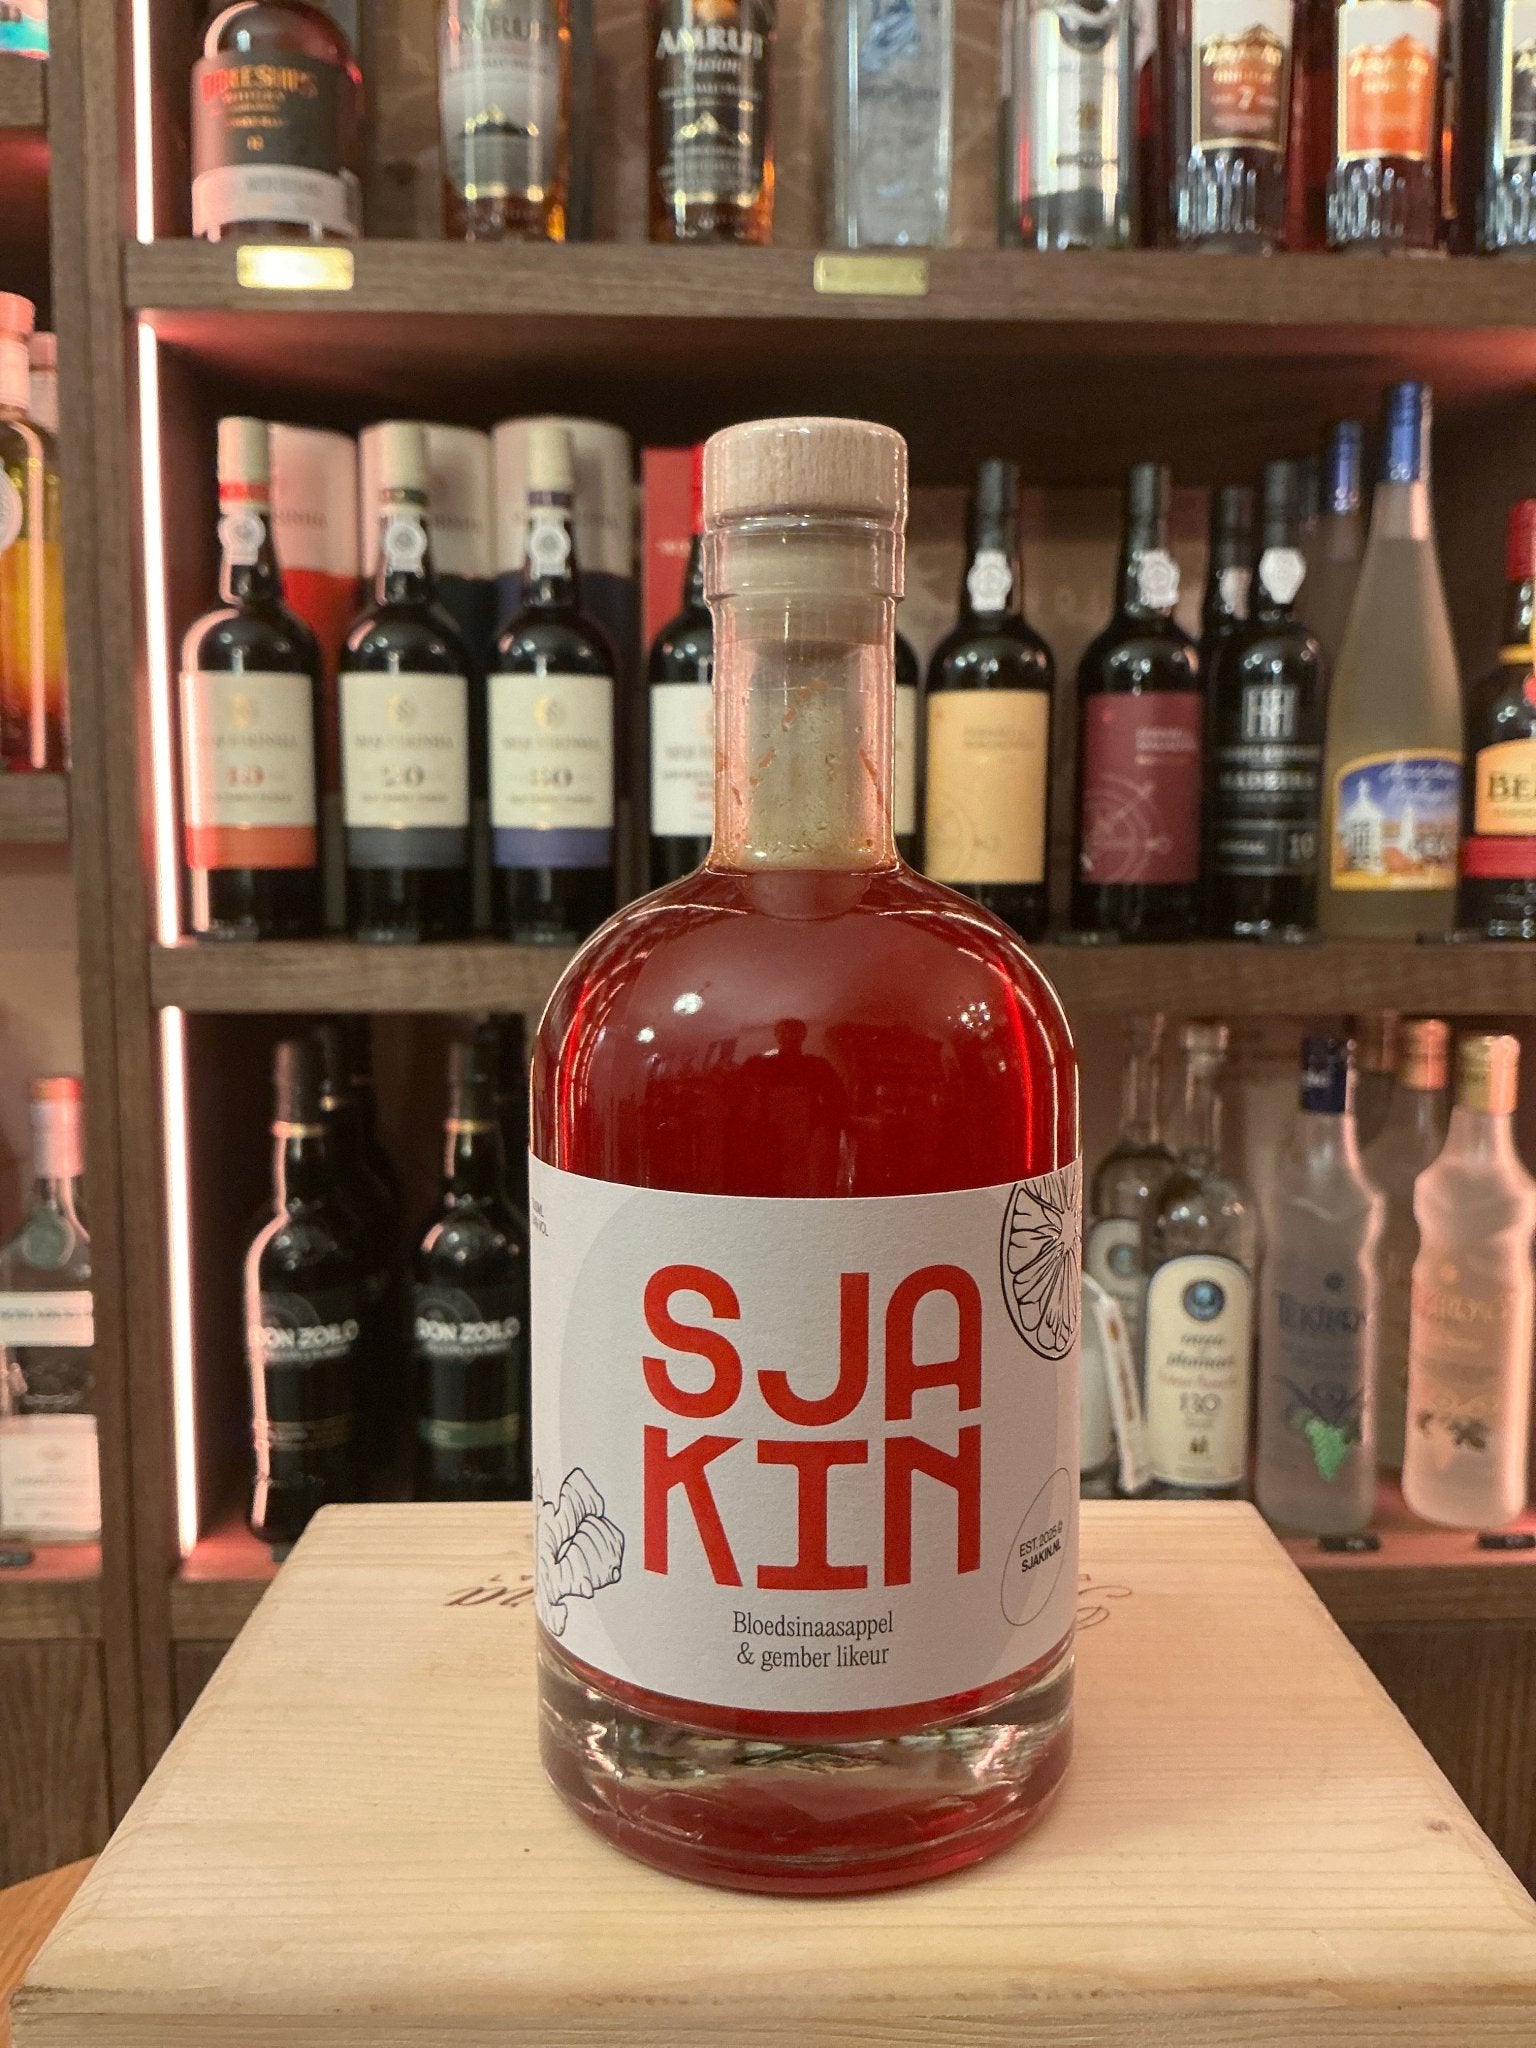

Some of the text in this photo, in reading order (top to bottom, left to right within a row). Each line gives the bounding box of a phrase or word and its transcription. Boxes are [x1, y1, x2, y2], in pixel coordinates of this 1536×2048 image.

[1489, 771, 1536, 803] BE
[414, 1315, 521, 1344] DON ZOILO
[643, 1264, 982, 1426] SJA
[643, 1424, 982, 1590] KIN
[732, 1610, 894, 1641] Bloedsinaasappel
[736, 1641, 890, 1672] & gember likeur
